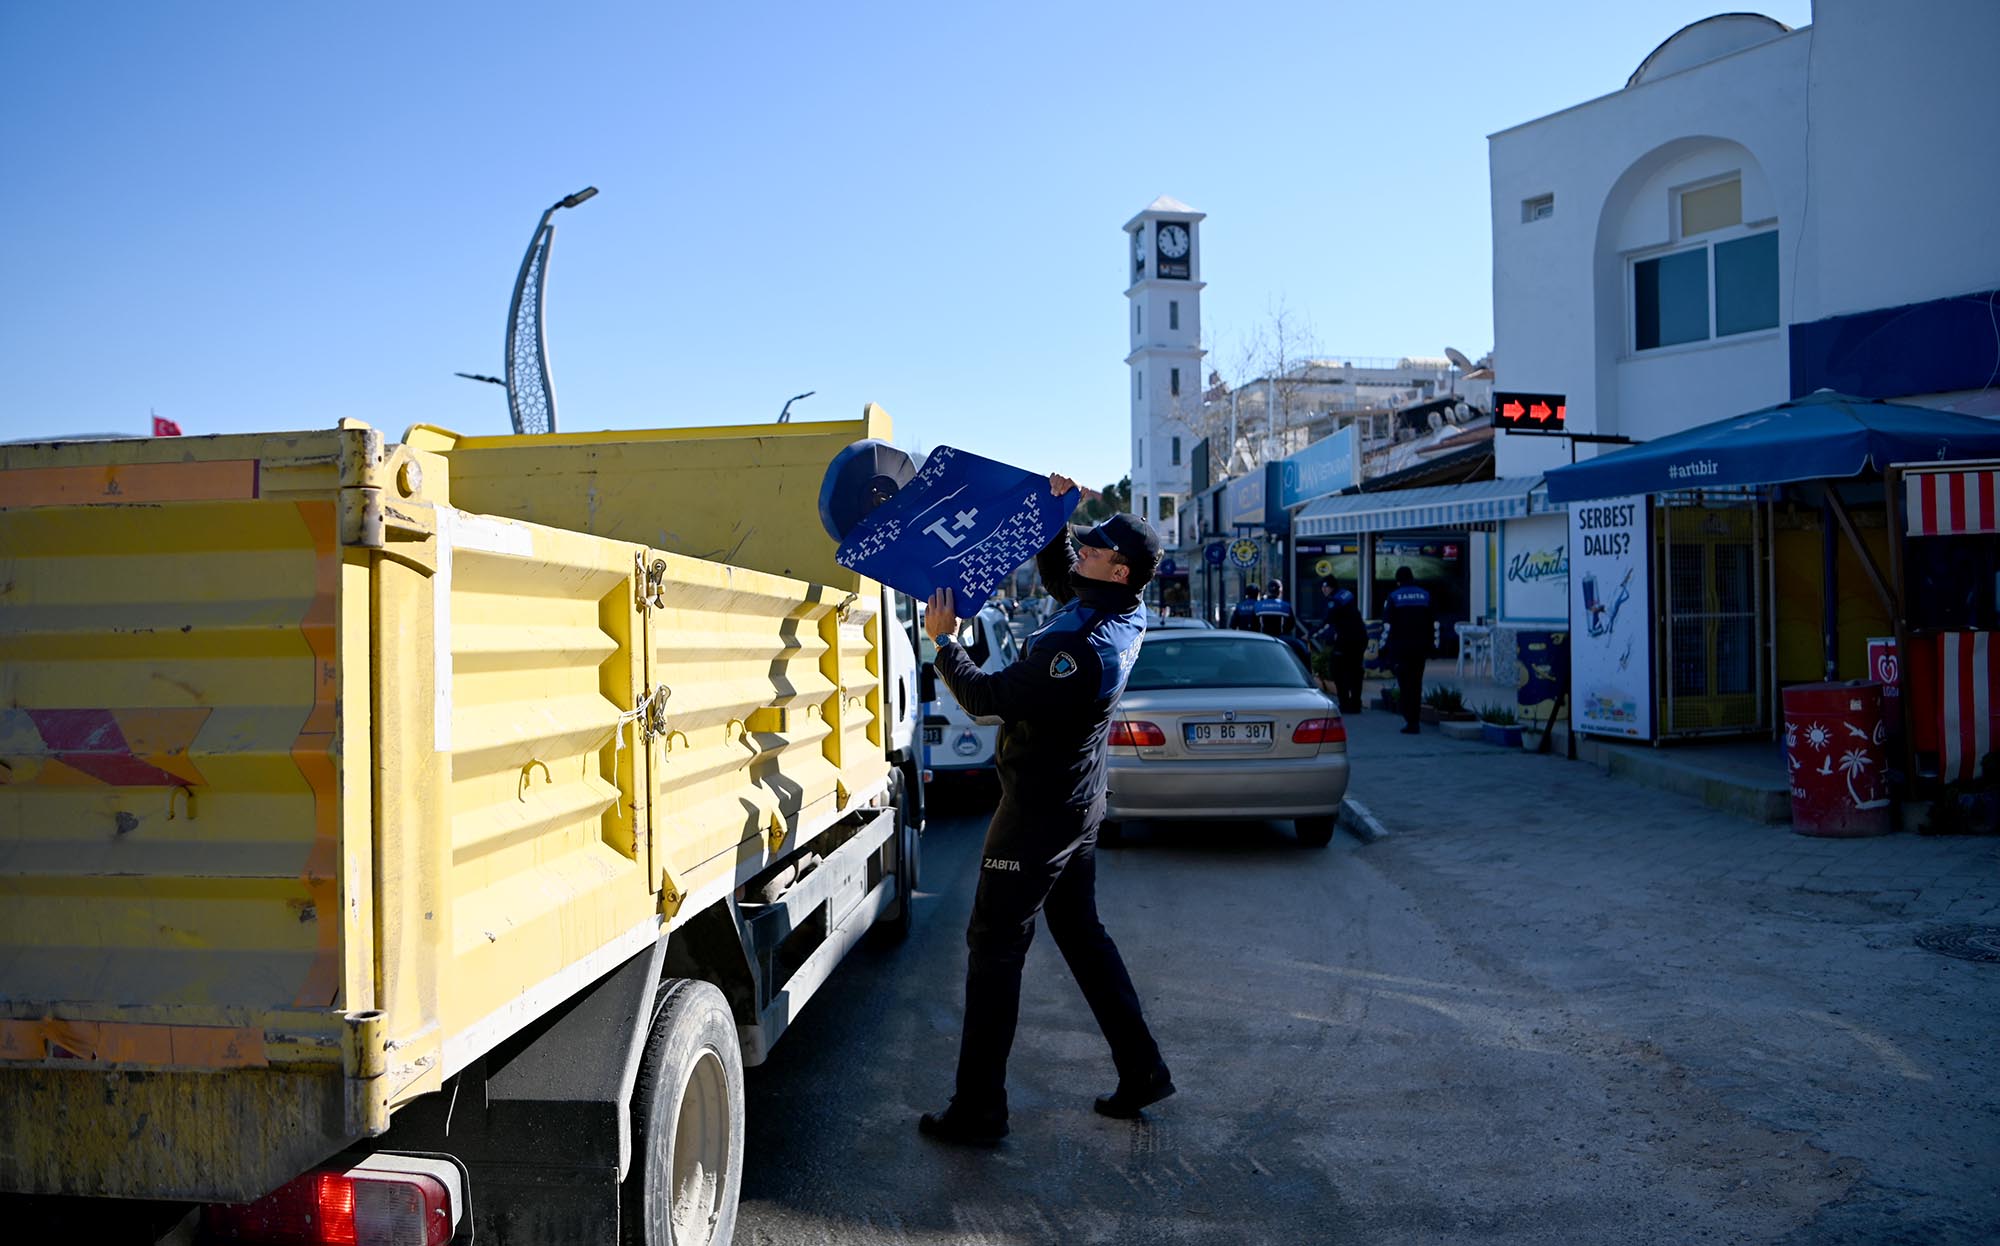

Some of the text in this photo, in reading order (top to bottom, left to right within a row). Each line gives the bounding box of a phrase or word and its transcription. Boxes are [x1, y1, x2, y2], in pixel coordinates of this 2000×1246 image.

[1579, 504, 1635, 530] SERBEST
[1584, 533, 1630, 560] DALIŞ?
[1196, 725, 1211, 739] 09
[1221, 725, 1236, 739] BG
[1246, 725, 1267, 739] 387
[983, 857, 1021, 872] ZABITA
